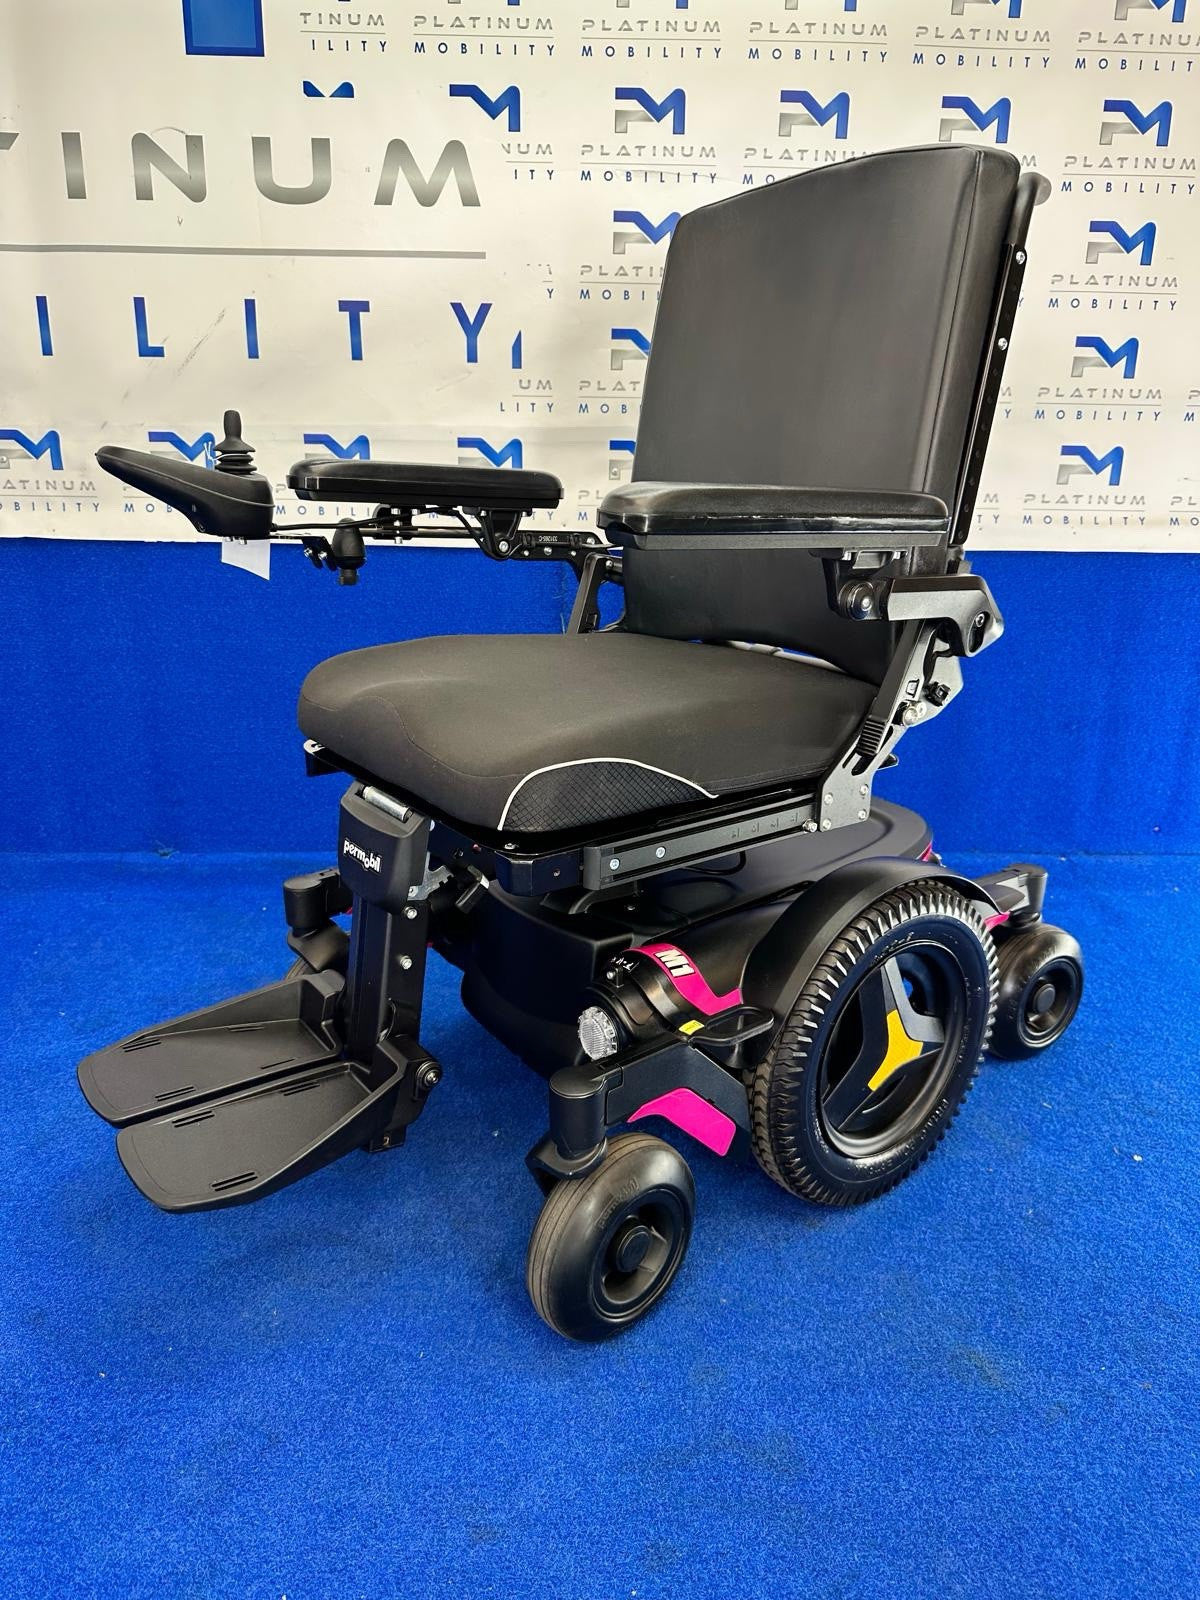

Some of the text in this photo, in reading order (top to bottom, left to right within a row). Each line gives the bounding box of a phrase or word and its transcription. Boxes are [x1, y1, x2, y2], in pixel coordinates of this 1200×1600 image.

[414, 16, 552, 30] PLATINUM
[582, 20, 720, 32] PLATINUM
[750, 22, 887, 36] PLATINUM
[916, 26, 1050, 42] PLATINUM
[312, 40, 386, 52] ILITY
[415, 42, 554, 56] MOBILITY
[582, 46, 721, 58] MOBILITY
[748, 48, 887, 63] MOBILITY
[913, 53, 1049, 68] MOBILITY
[1075, 58, 1192, 72] MOBILIT
[581, 145, 715, 158] PLATINUM
[0, 132, 481, 207] INUM
[1065, 156, 1196, 170] PLATINUM
[581, 170, 716, 183] MOBILITY
[1061, 181, 1194, 194] MOBILITY
[1051, 274, 1177, 287] PLATINUM
[1048, 298, 1176, 310] MOBILITY
[36, 294, 492, 363] ILITY
[1038, 387, 1161, 399] PLATINUM
[1035, 410, 1160, 421] MOBILITY
[1024, 494, 1145, 505] PLATINUM
[1023, 515, 1145, 525] MOBILITY
[342, 836, 384, 874] permobil
[655, 949, 694, 976] M1
